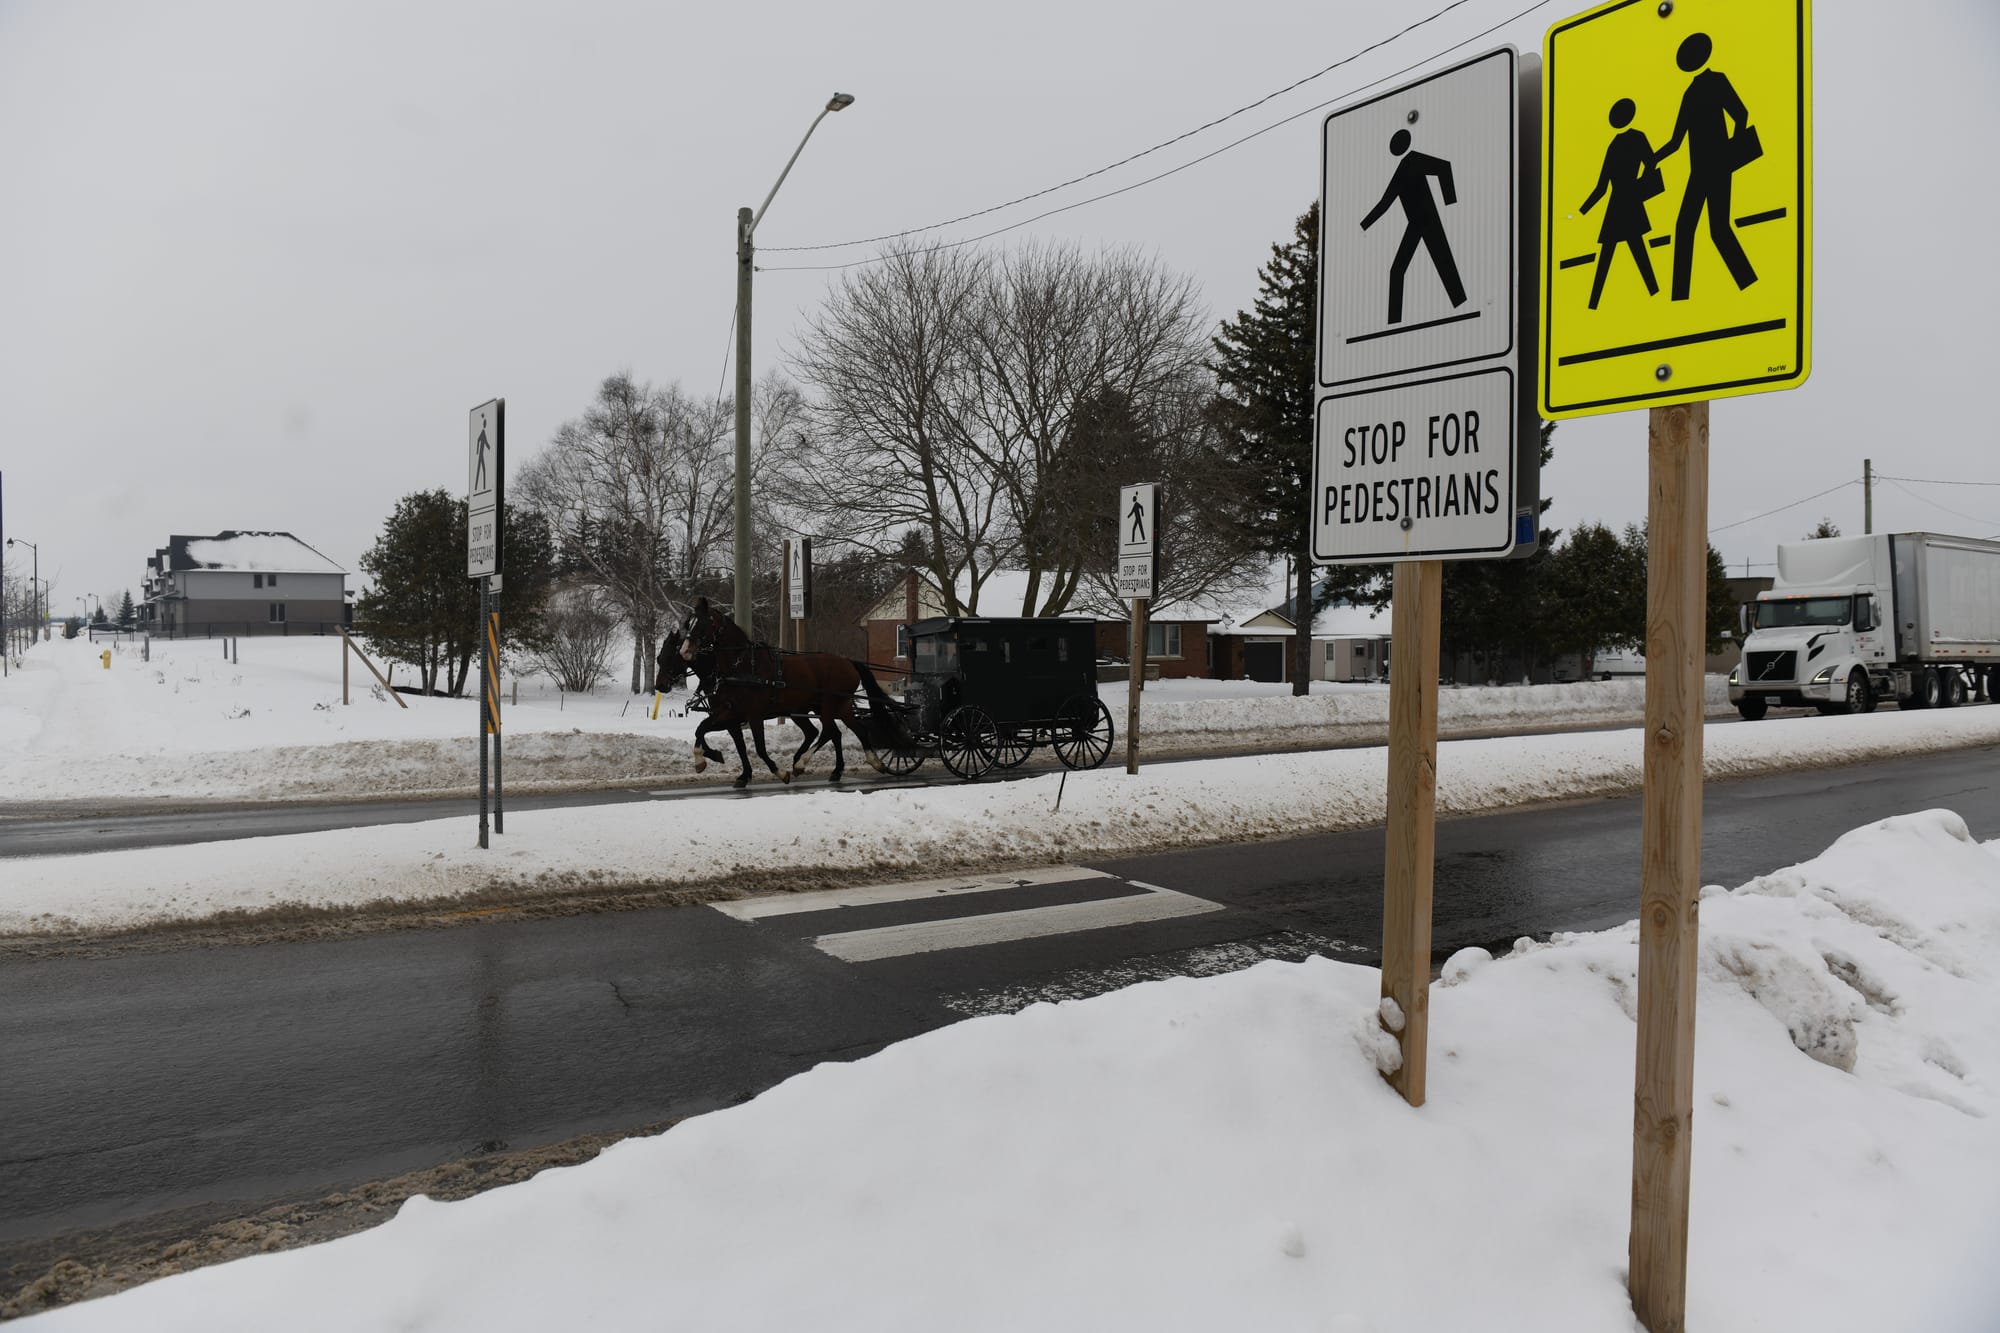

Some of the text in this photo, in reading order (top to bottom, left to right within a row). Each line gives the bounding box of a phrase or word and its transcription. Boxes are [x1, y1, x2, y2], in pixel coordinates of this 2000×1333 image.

[1343, 410, 1480, 469] STOP FOR
[1324, 469, 1499, 525] PEDESTRIANS
[472, 523, 492, 543] STOP FOR
[470, 544, 495, 564] PEDESTRIANS
[1123, 564, 1147, 576] STOP FOR
[1120, 578, 1150, 590] PEDESTRIANS
